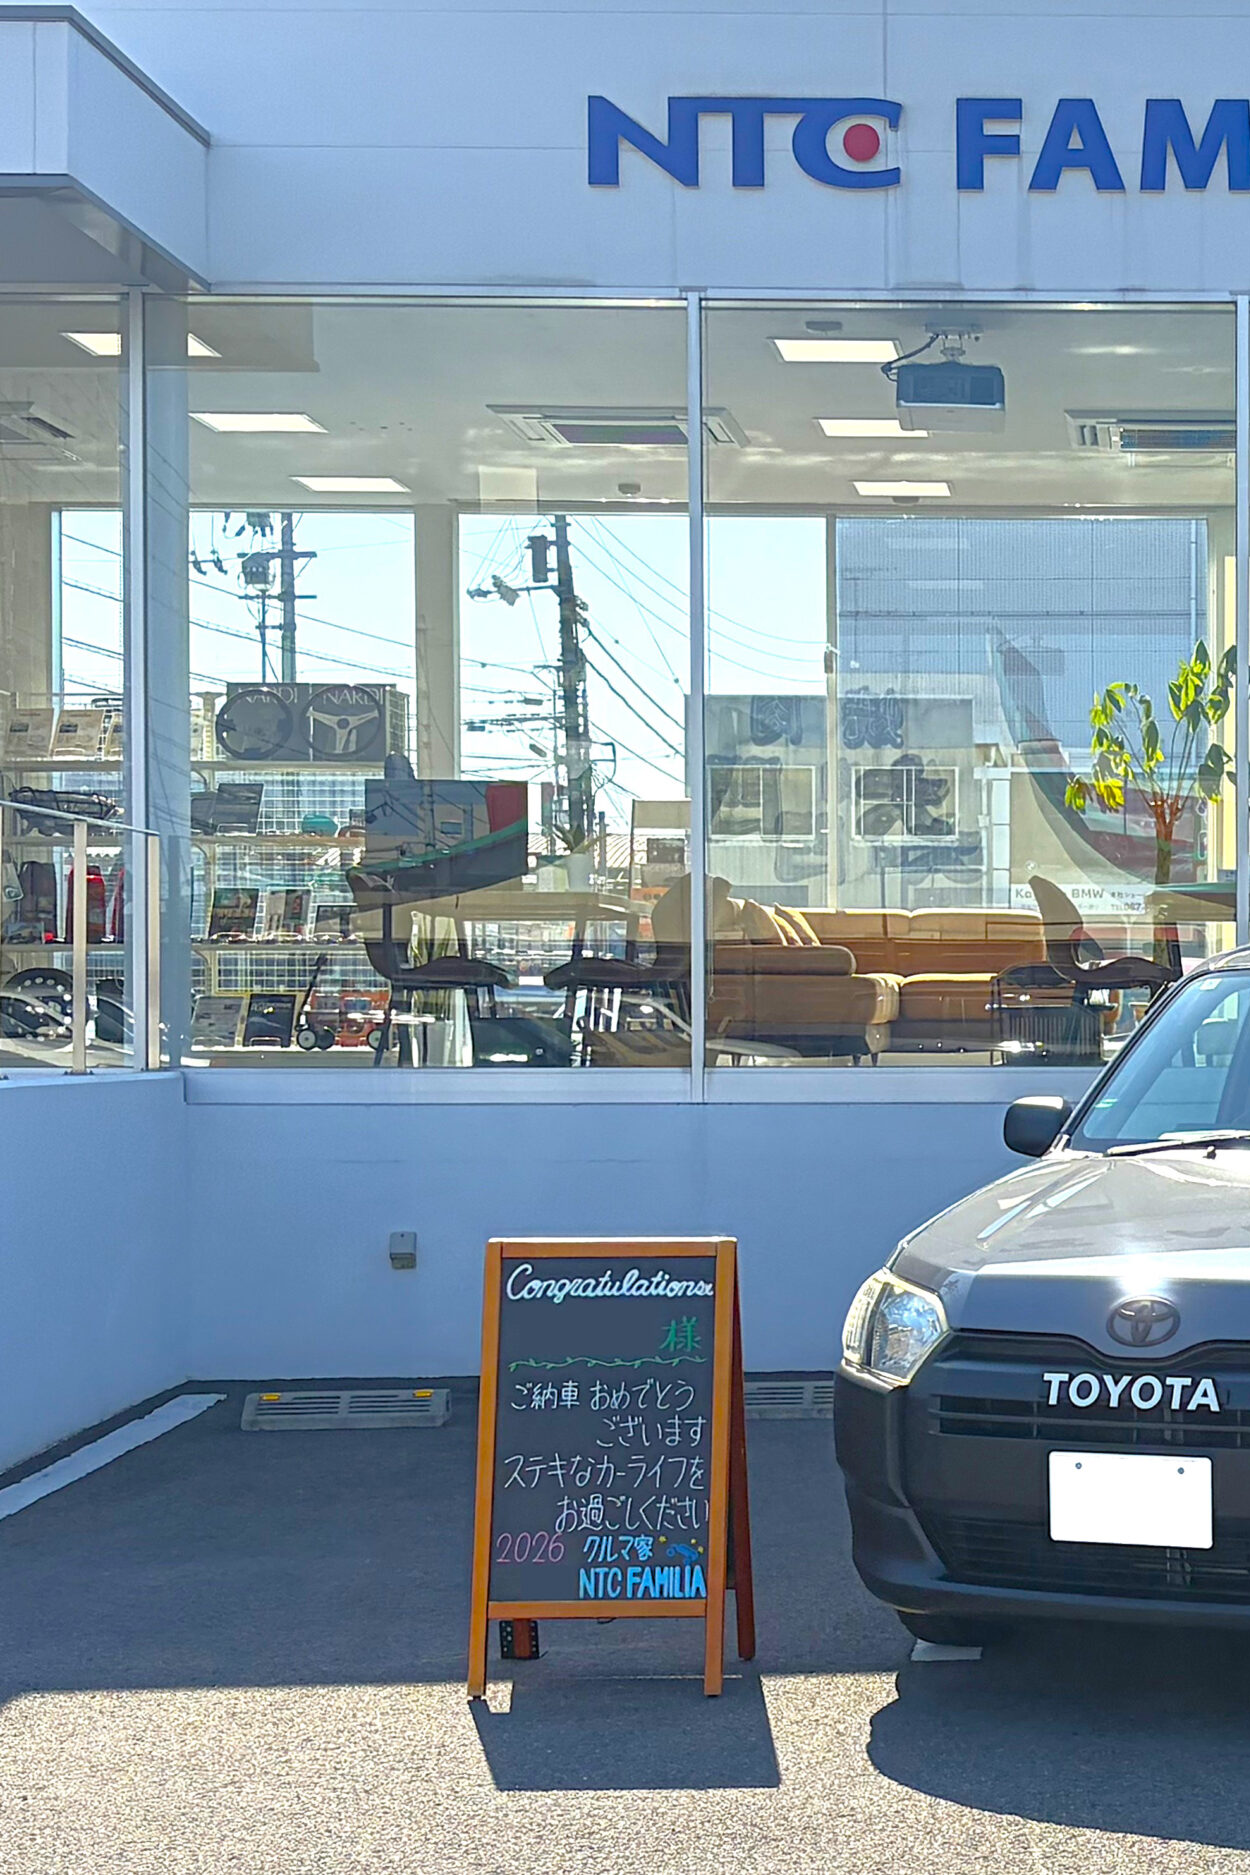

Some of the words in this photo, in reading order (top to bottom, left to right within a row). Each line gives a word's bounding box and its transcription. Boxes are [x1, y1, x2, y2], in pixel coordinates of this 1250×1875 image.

[588, 95, 903, 189] NTC
[1071, 888, 1106, 899] BMW
[659, 1316, 702, 1353] 様
[511, 1380, 580, 1410] ご納車
[589, 1378, 695, 1411] おめでとう
[1043, 1372, 1221, 1412] TOYOTA
[596, 1415, 707, 1447] ございます
[504, 1453, 705, 1489] ステキなカーライフを
[554, 1493, 709, 1533] お過ごしください
[496, 1531, 565, 1562] 2026
[583, 1534, 653, 1563] クルマ家
[579, 1567, 622, 1599] NTC
[626, 1565, 707, 1599] FAMILIA
